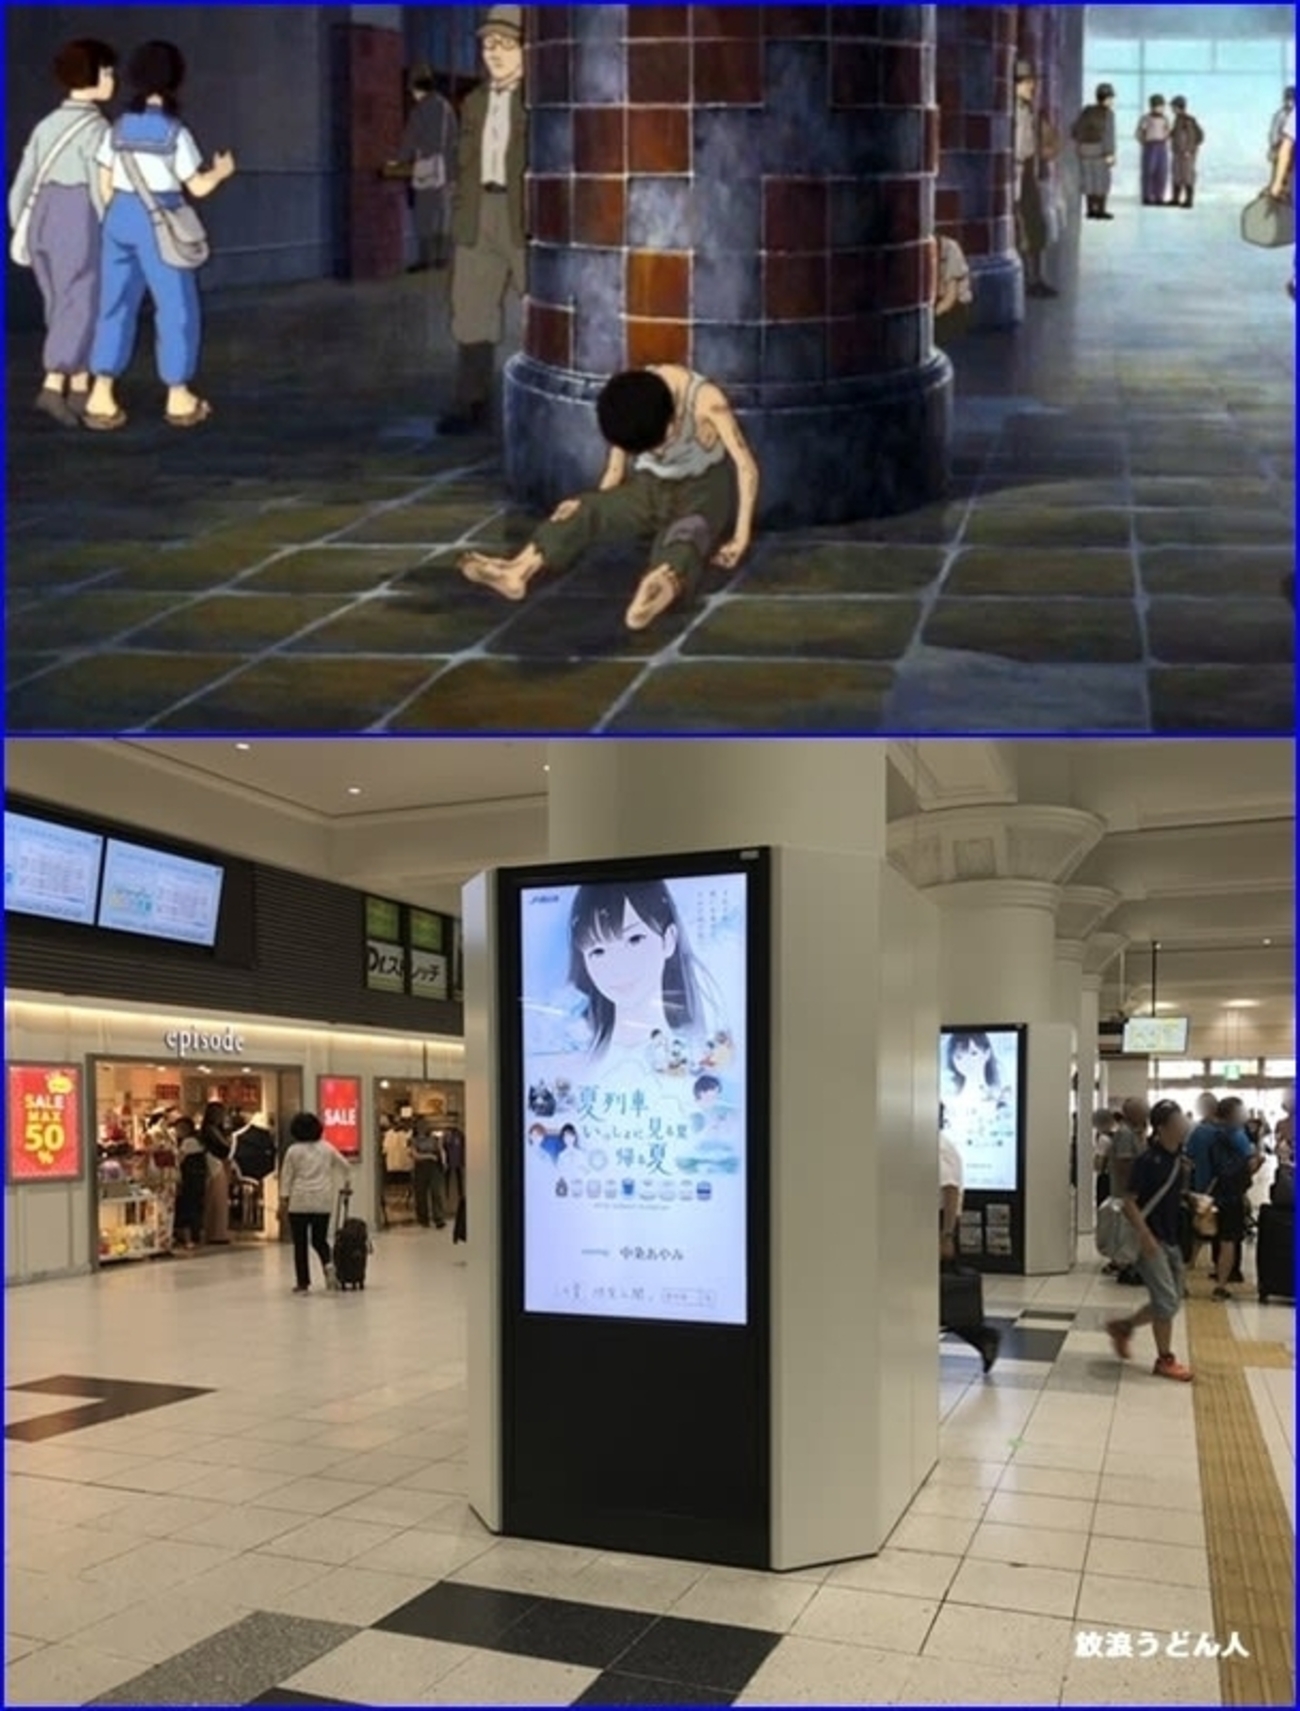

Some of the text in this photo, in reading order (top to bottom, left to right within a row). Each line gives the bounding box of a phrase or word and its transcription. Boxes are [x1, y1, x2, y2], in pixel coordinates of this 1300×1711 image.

[165, 1025, 245, 1058] episode
[24, 1093, 65, 1111] SALE
[577, 1085, 650, 1122] 夏列車
[27, 1110, 62, 1123] MAX
[324, 1107, 356, 1126] SALE
[24, 1123, 65, 1151] 50
